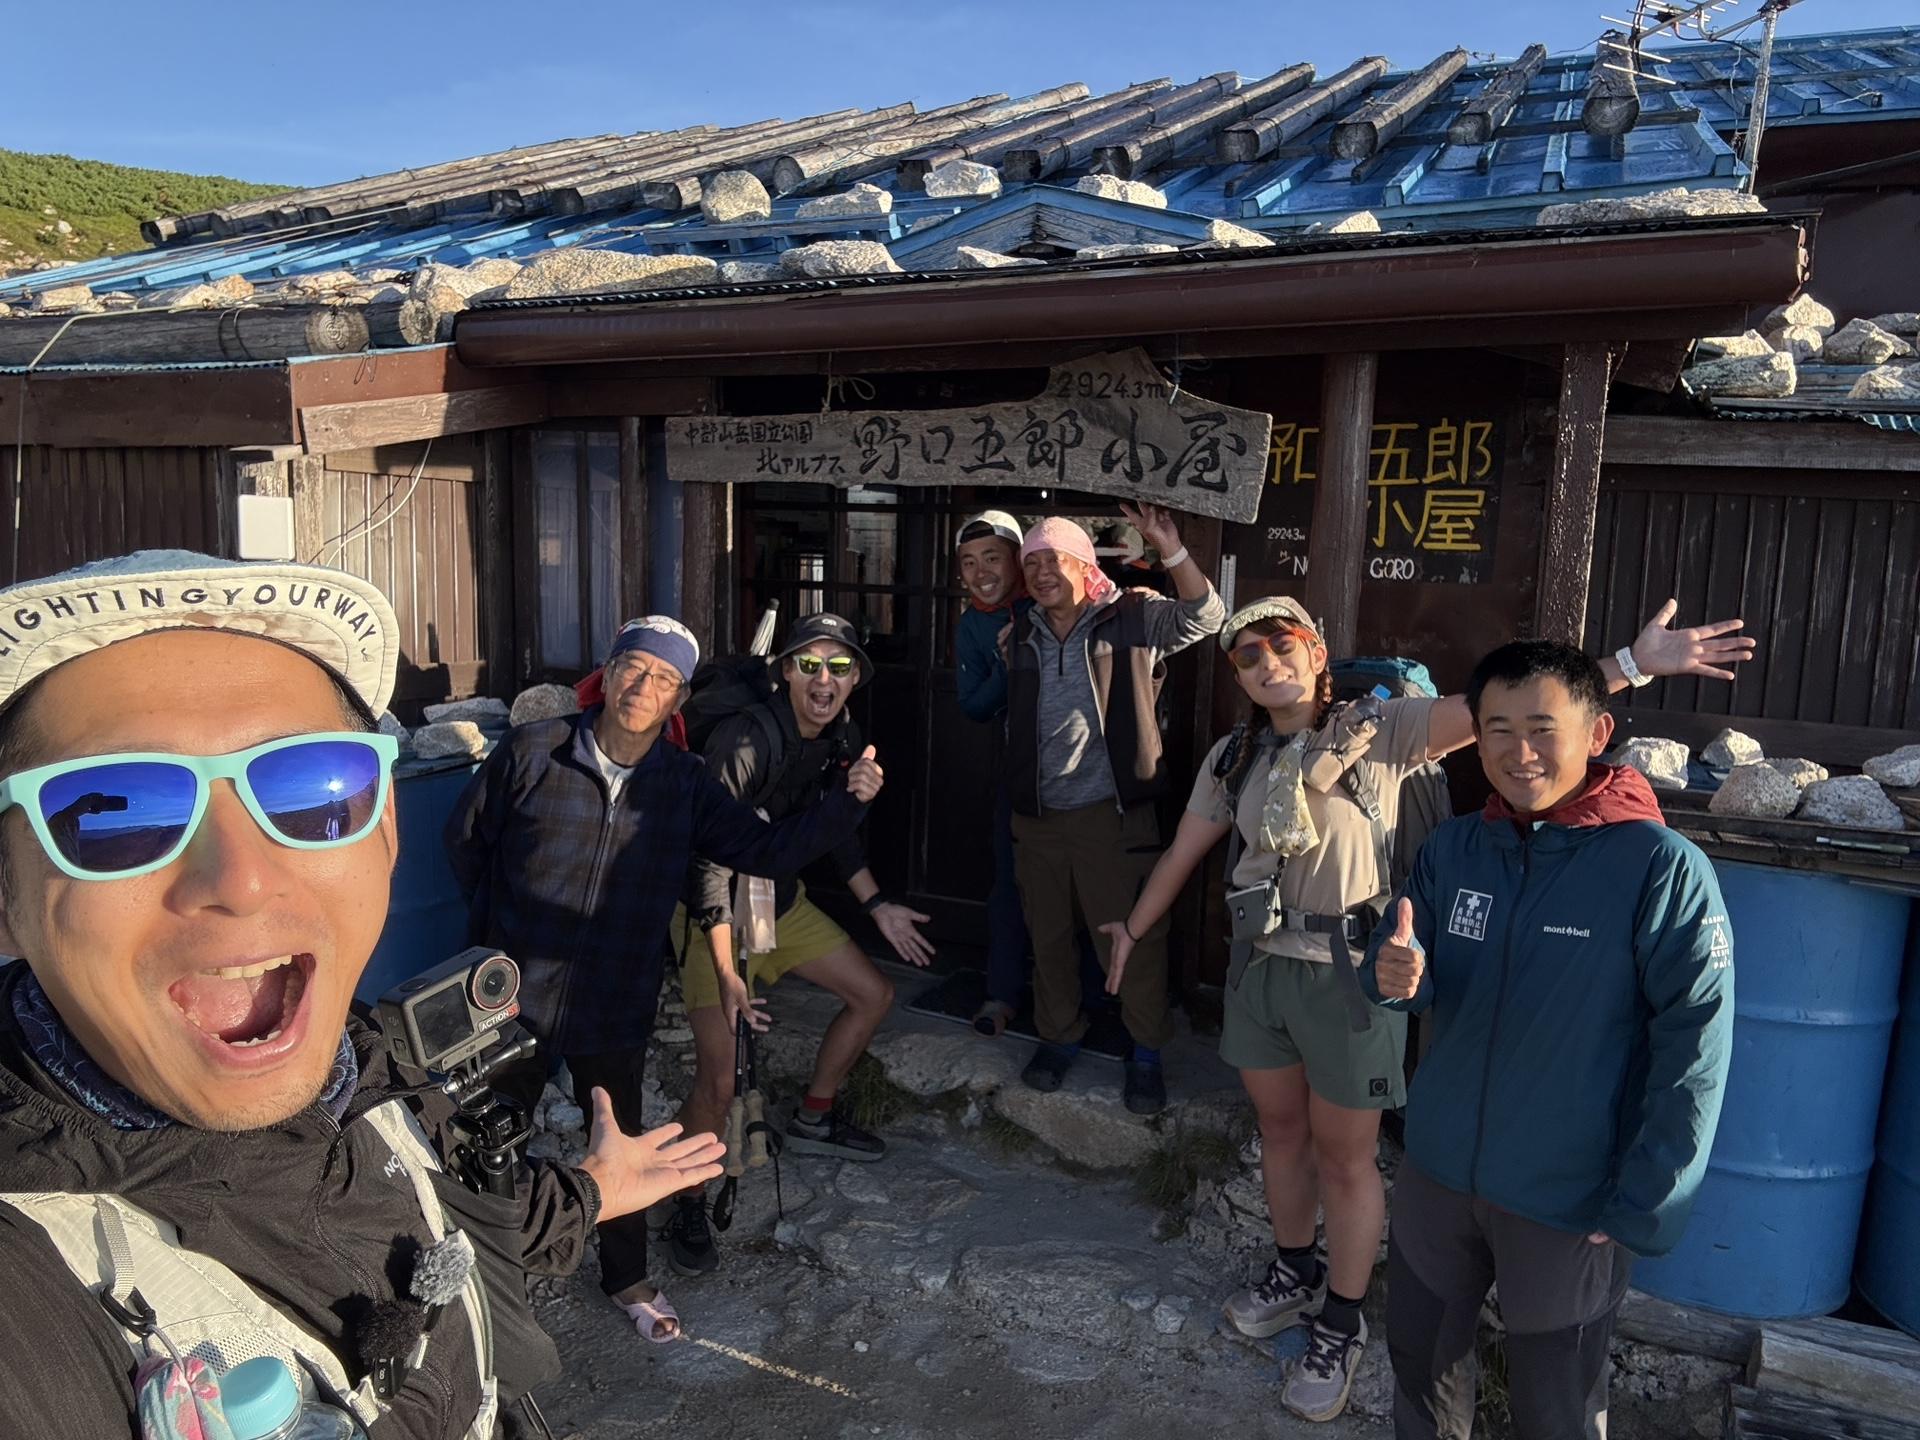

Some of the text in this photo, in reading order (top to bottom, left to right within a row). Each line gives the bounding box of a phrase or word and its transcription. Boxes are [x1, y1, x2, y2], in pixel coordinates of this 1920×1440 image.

[1056, 371, 1168, 399] 2924.3m
[757, 447, 845, 475] 北アルプス
[854, 406, 1247, 492] 野口五郎小屋
[1370, 557, 1415, 580] GORO
